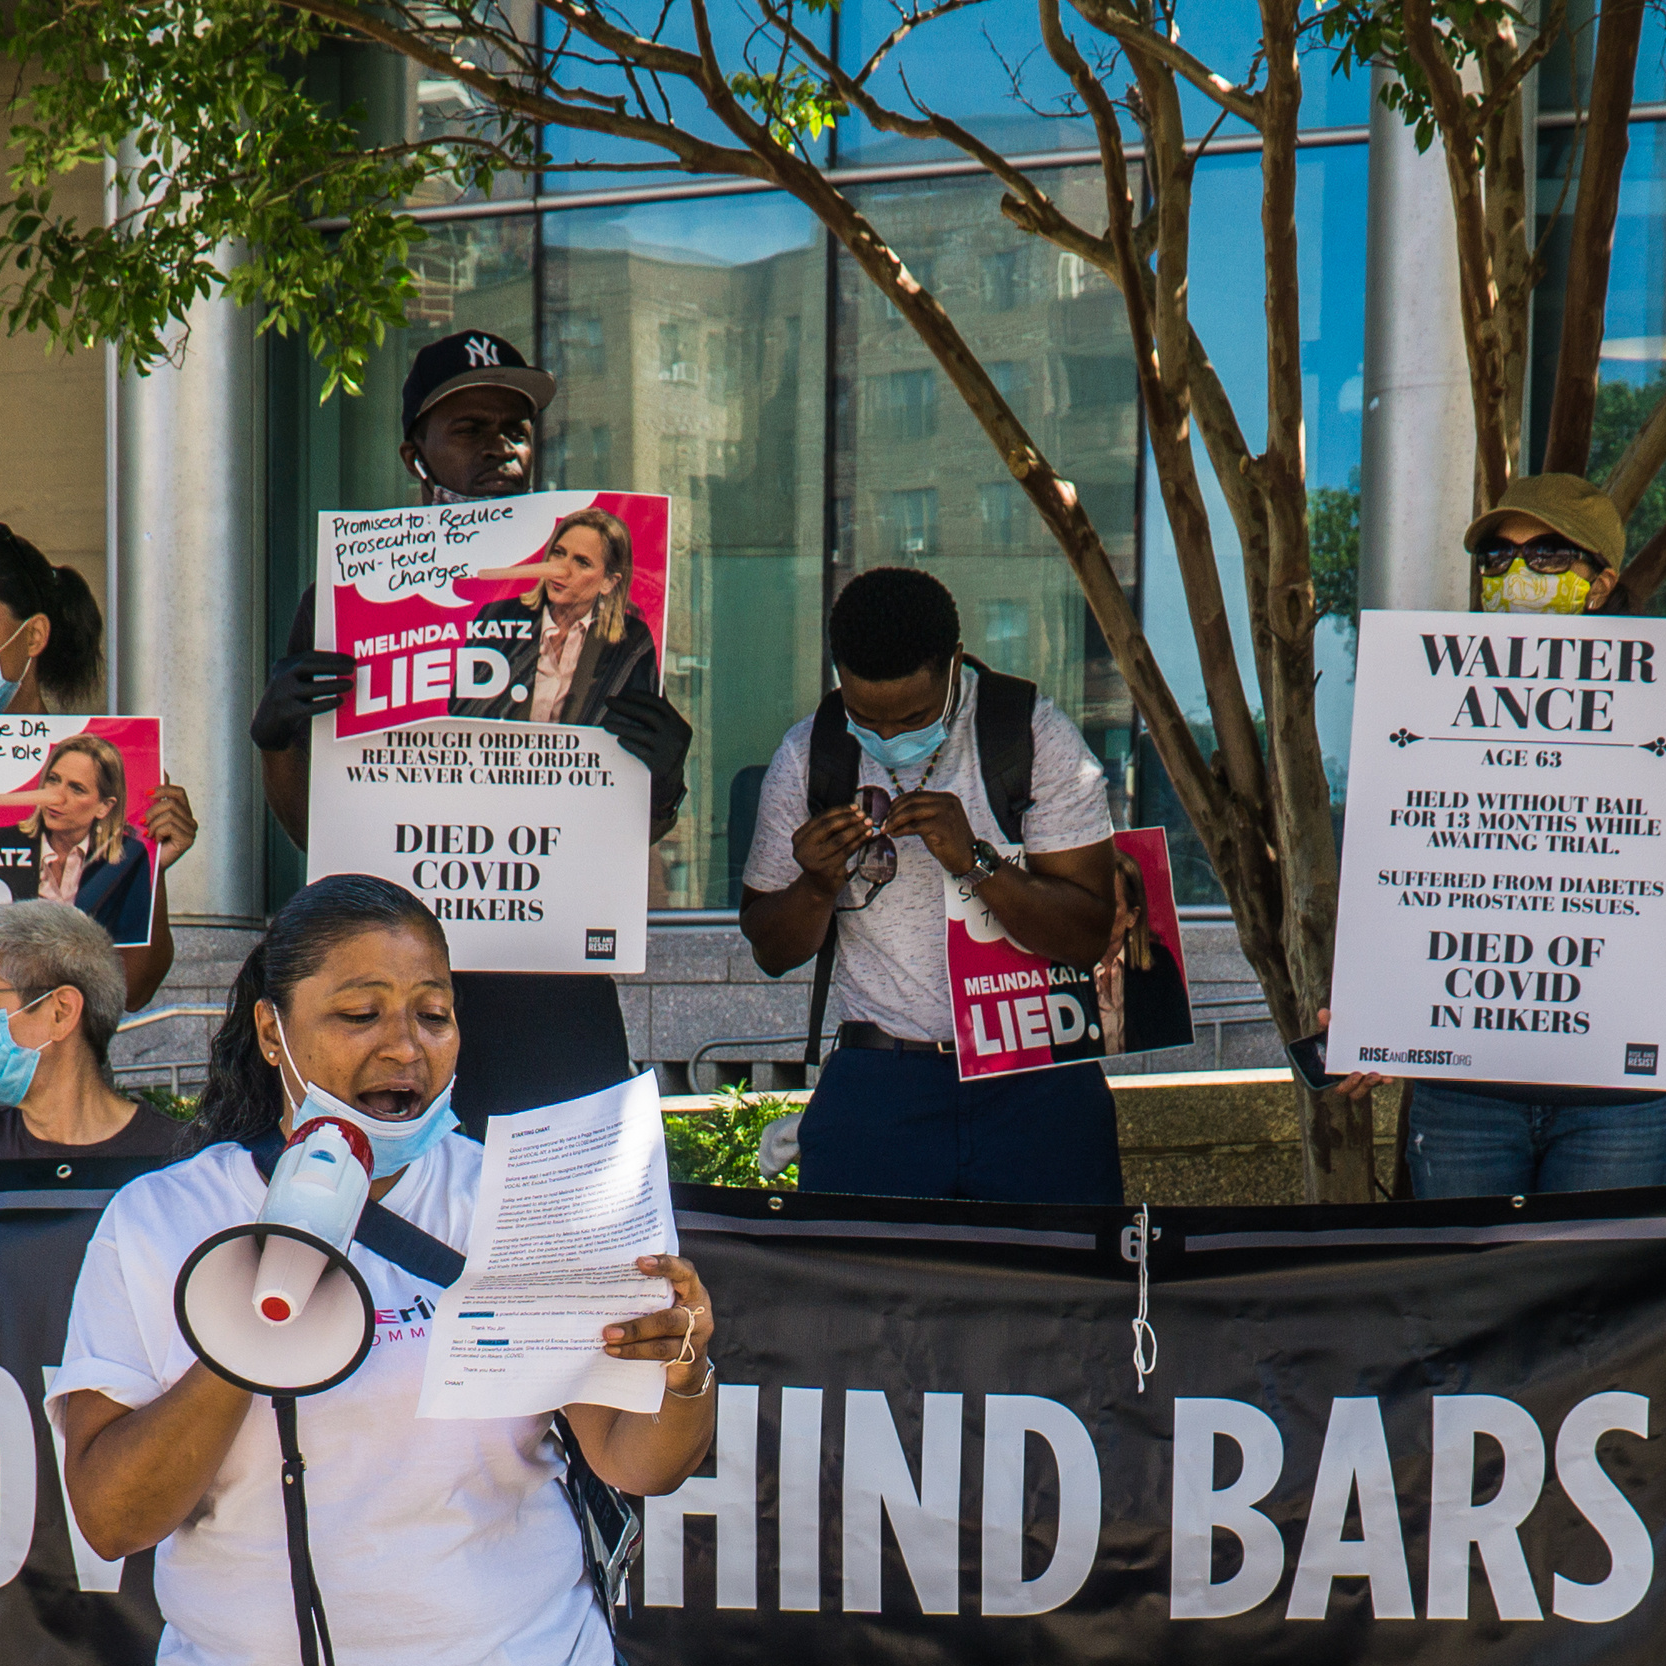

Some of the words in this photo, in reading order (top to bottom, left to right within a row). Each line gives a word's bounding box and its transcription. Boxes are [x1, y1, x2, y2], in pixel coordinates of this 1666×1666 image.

[332, 515, 404, 538] Promised
[439, 504, 513, 528] Reduce
[336, 530, 436, 558] prosecution
[443, 527, 480, 545] for
[353, 626, 460, 659] MELINDA
[466, 620, 532, 639] KATZ
[1421, 634, 1657, 683] WALTER
[355, 647, 528, 716] LIED.
[1451, 685, 1613, 732] ANCE
[19, 719, 50, 737] DA
[382, 731, 472, 748] THOUGH
[478, 733, 579, 750] ORDERED
[11, 744, 41, 762] role
[362, 748, 473, 766] RELEASED,
[480, 750, 521, 766] THE
[528, 752, 600, 768] ORDER
[1481, 749, 1527, 766] AGE
[1535, 750, 1562, 768] 63
[346, 766, 388, 782] WAS
[396, 767, 462, 784] NEVER
[469, 768, 562, 785] CARRIED
[568, 770, 614, 787] OUT.
[1406, 790, 1469, 808] HELD
[1477, 792, 1589, 813] WITHOUT
[1595, 797, 1648, 815] BAIL
[1390, 809, 1436, 827] FOR
[1447, 811, 1470, 828] 13
[1479, 812, 1576, 832] MONTHS
[1586, 816, 1661, 836] WHILE
[395, 824, 494, 854] DIED
[508, 826, 561, 856] OF
[1427, 831, 1538, 852] AWAITING
[1545, 834, 1620, 854] TRIAL.
[412, 860, 540, 891] COVID
[1378, 870, 1486, 888] SUFFERED
[1492, 874, 1553, 892] FROM
[1559, 877, 1664, 896] DIABETES
[433, 898, 544, 922] RIKERS
[1398, 891, 1441, 907] AND
[1448, 892, 1554, 911] PROSTATE
[1561, 897, 1640, 916] ISSUES.
[1428, 931, 1533, 964] DIED
[1547, 936, 1605, 967] OF
[964, 970, 1044, 996] MELINDA
[1445, 967, 1581, 1002] COVID
[970, 993, 1100, 1056] LIED.
[1430, 1004, 1463, 1028] IN
[1473, 1007, 1590, 1034] RIKERS
[1169, 1391, 1654, 1624] BARS
